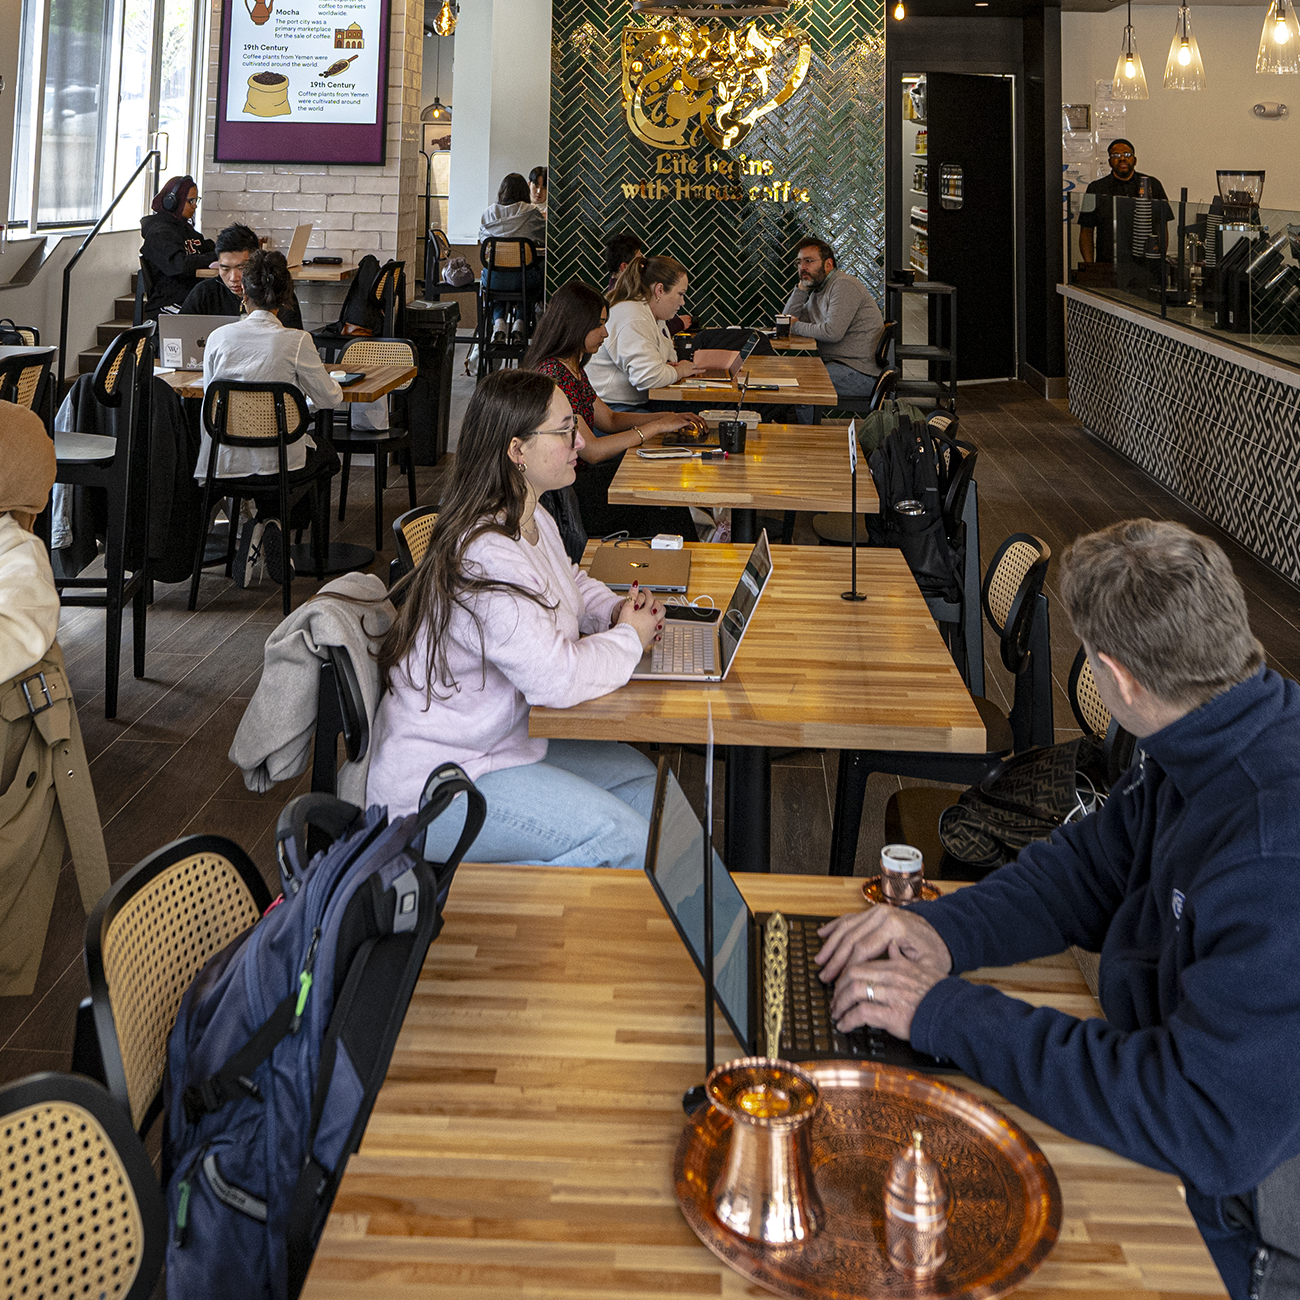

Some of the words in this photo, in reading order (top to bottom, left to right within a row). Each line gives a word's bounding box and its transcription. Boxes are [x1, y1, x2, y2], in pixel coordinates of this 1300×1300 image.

[299, 18, 311, 26] city
[260, 44, 289, 53] Century
[326, 81, 356, 90] Century
[656, 154, 697, 176] Life
[705, 154, 774, 179] begins
[620, 181, 668, 200] with
[675, 180, 742, 201] Haraz
[749, 181, 809, 203] coffee
